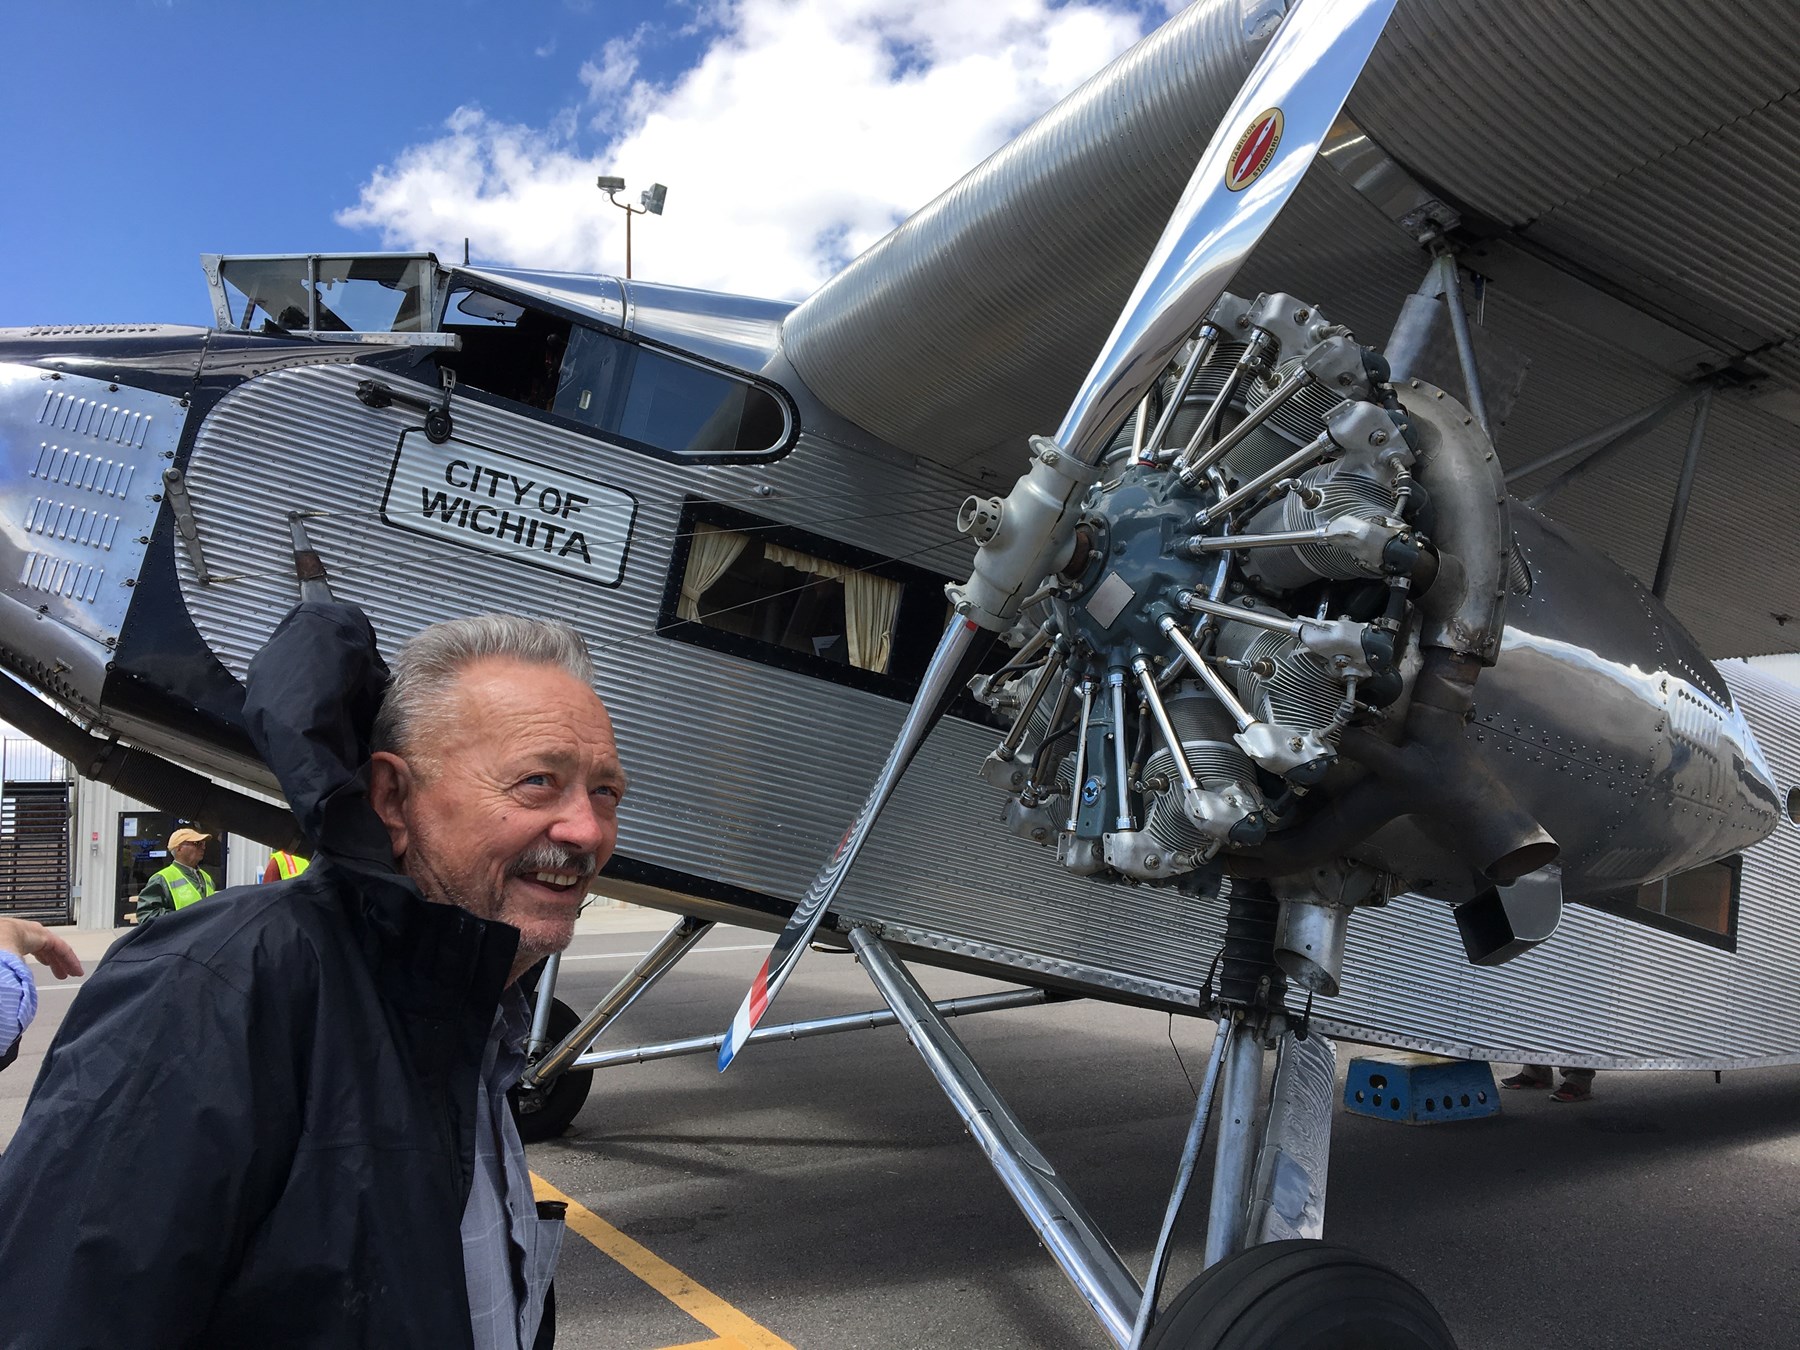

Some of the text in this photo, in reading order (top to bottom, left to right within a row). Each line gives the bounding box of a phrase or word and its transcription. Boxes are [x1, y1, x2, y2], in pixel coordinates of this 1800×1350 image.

[1231, 123, 1257, 162] HAMILTON
[1252, 135, 1279, 177] STANDARD
[445, 459, 589, 519] CITY OF
[421, 486, 592, 565] WICHITA
